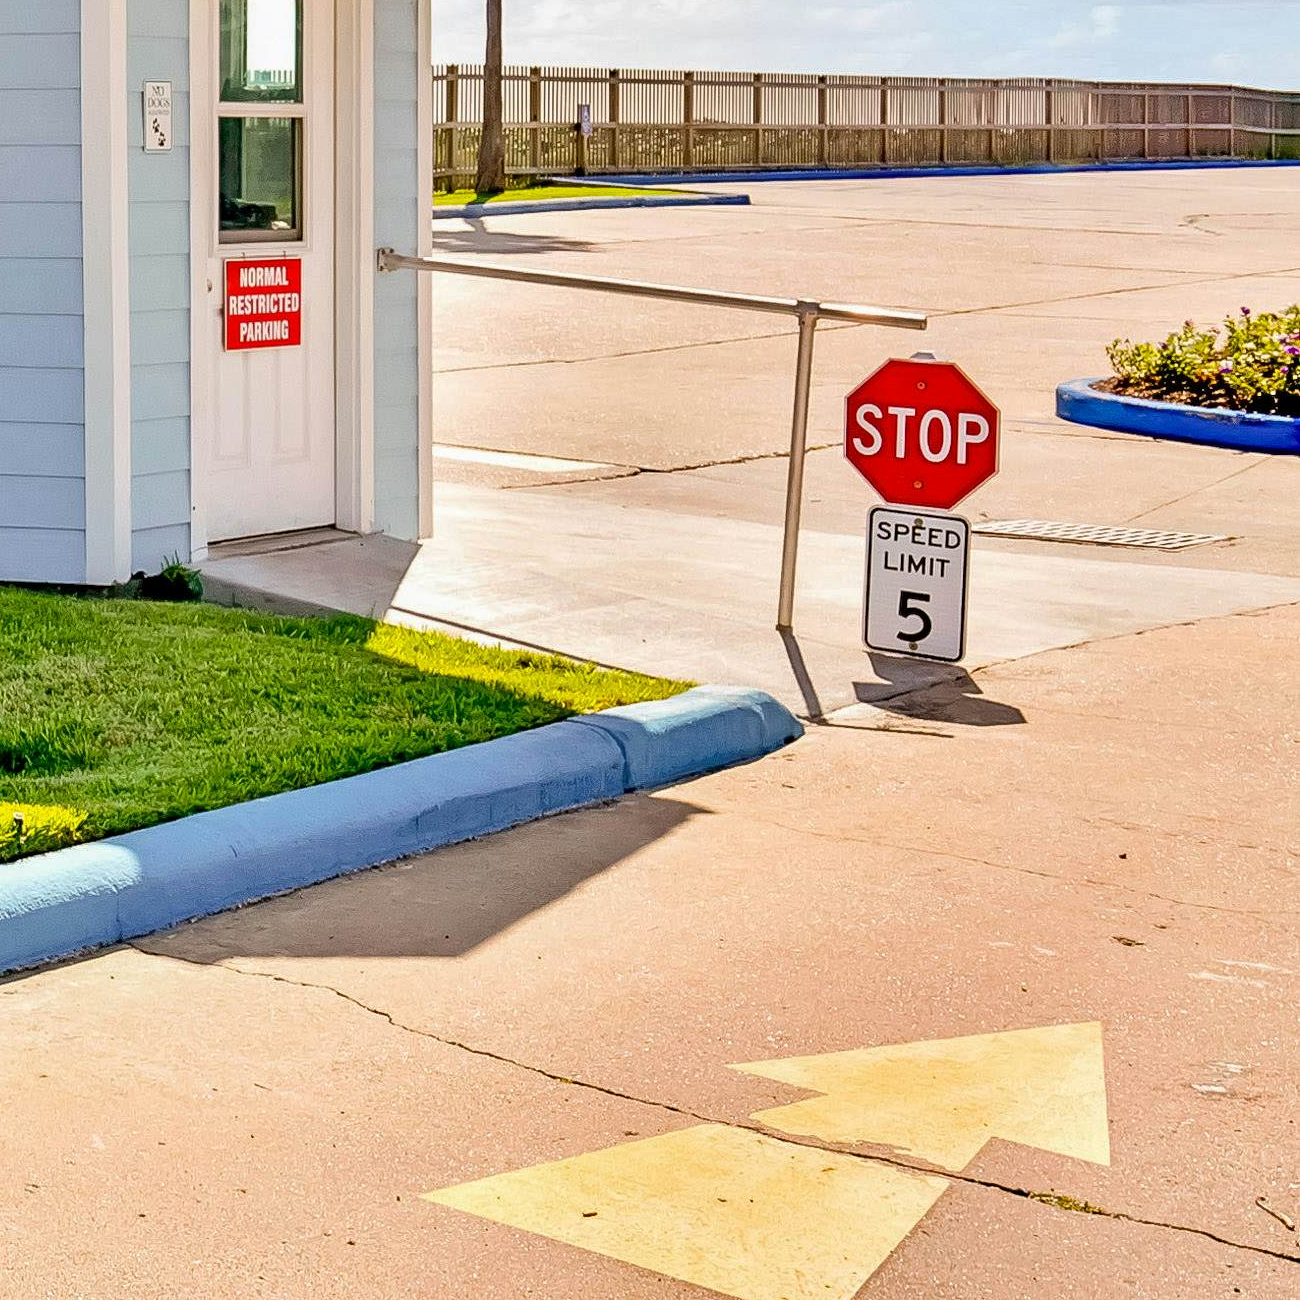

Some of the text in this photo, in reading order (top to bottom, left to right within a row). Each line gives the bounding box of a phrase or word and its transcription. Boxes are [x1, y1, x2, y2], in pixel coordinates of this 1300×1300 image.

[239, 267, 289, 288] NORMAL
[229, 293, 299, 316] RESTRICTED
[239, 322, 289, 343] PARKING
[852, 403, 990, 465] STOP
[876, 521, 961, 550] SPEED
[884, 551, 950, 578] LIMIT
[896, 590, 932, 642] 5
